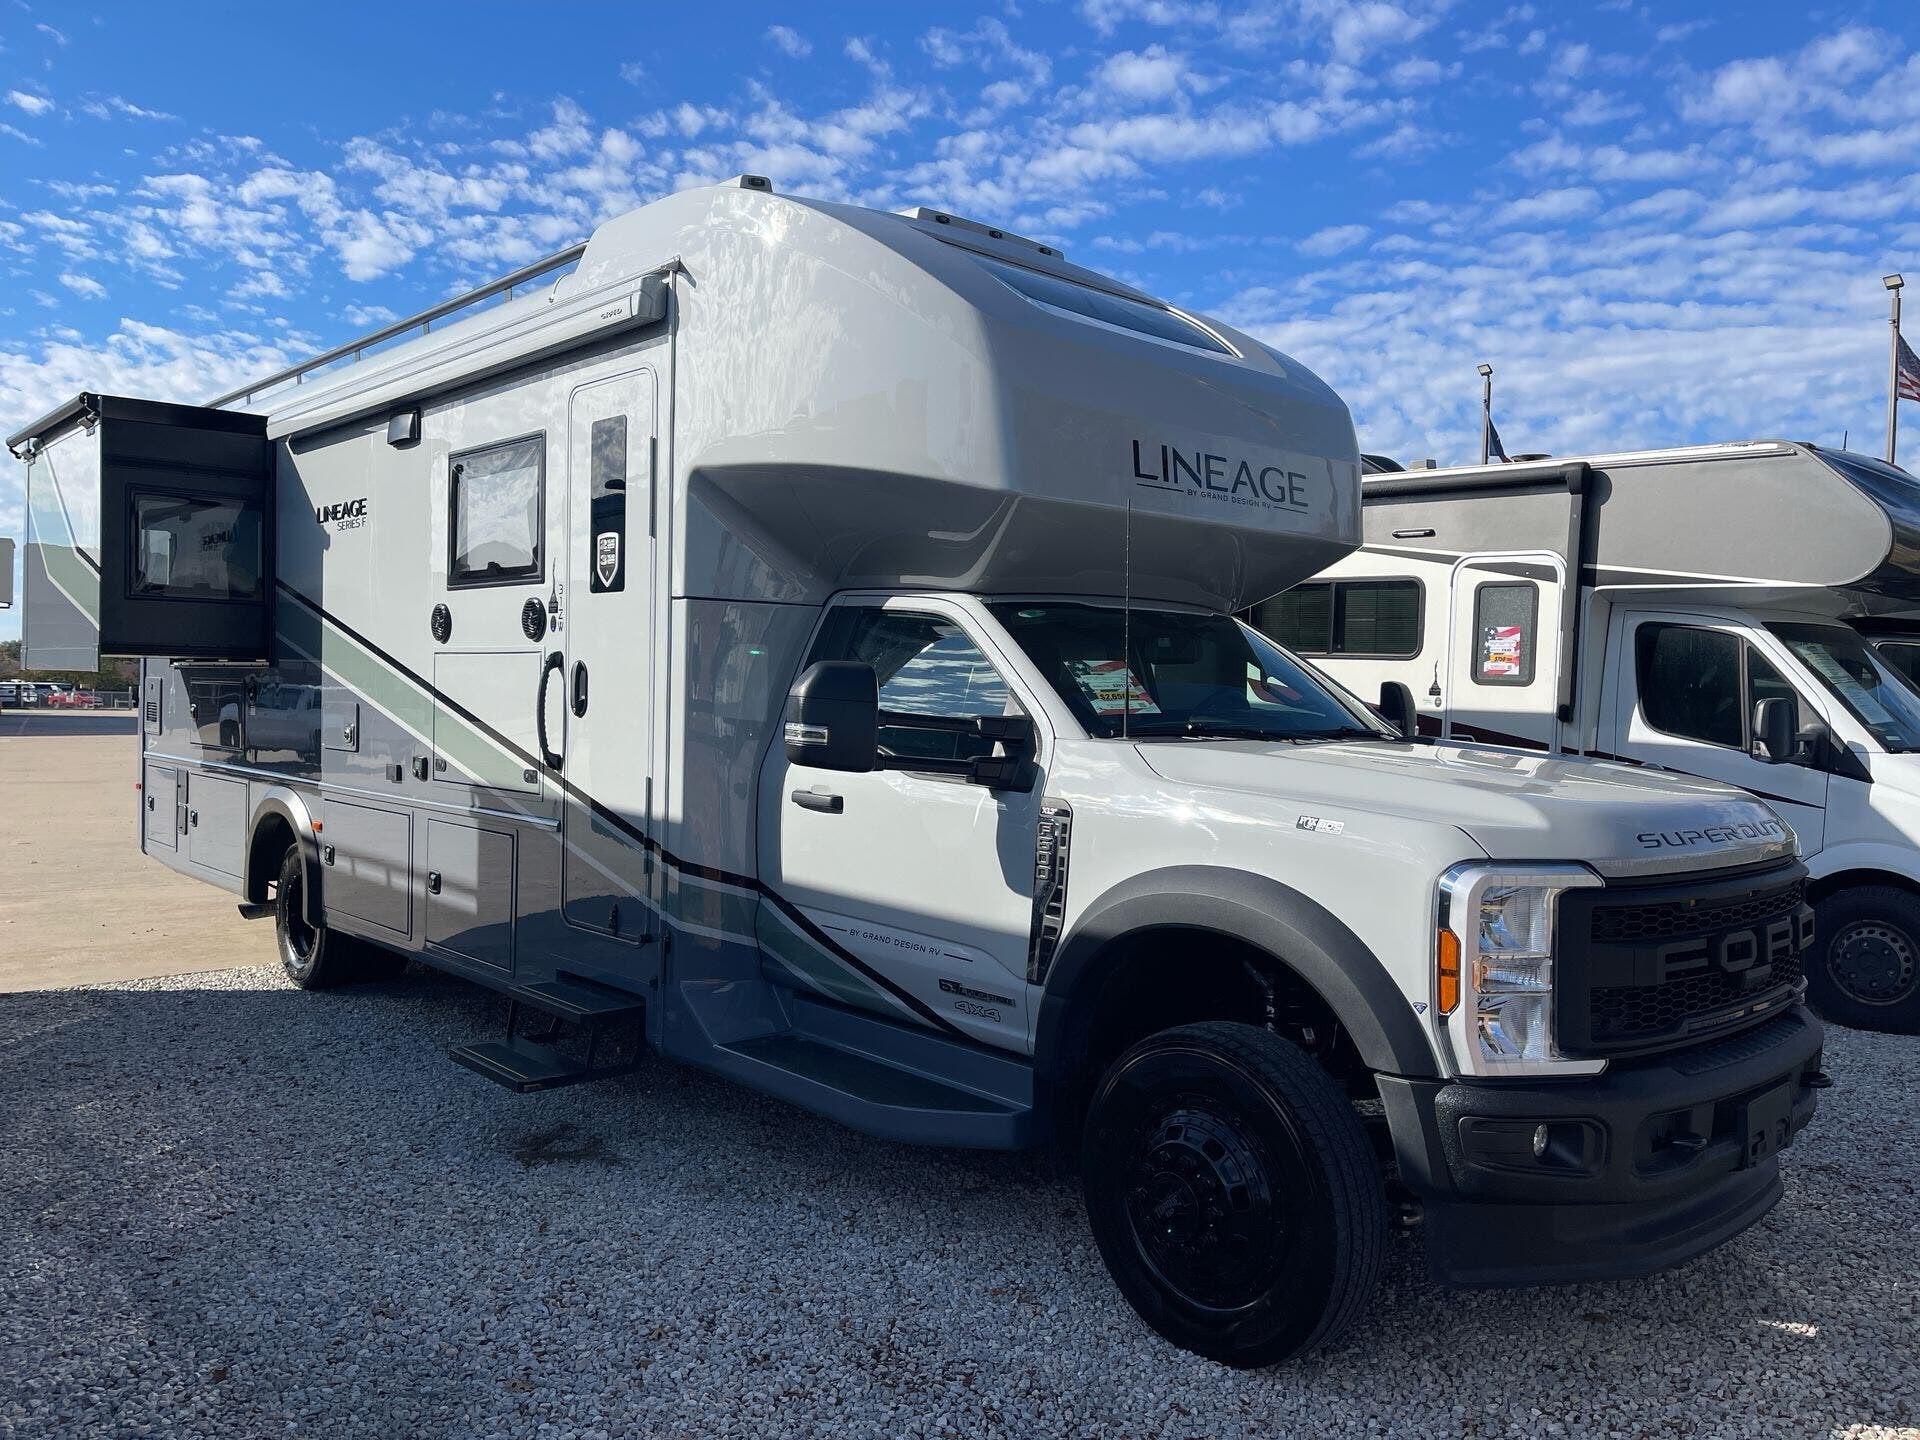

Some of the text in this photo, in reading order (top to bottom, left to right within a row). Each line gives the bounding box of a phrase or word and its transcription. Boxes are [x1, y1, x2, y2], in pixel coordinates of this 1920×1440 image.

[1133, 440, 1308, 507] LINEAGE
[1187, 488, 1197, 496] BY
[1200, 491, 1229, 502] GRAND
[1231, 496, 1260, 507] DESIGN
[316, 497, 368, 524] LINEAGE
[337, 516, 367, 531] SERIES F
[1041, 806, 1058, 815] XLT
[1299, 816, 1319, 829] FOX
[1636, 826, 1744, 849] SUPER
[849, 928, 941, 956] BY GRAND DESIGN RV
[1656, 905, 1816, 986] FORD
